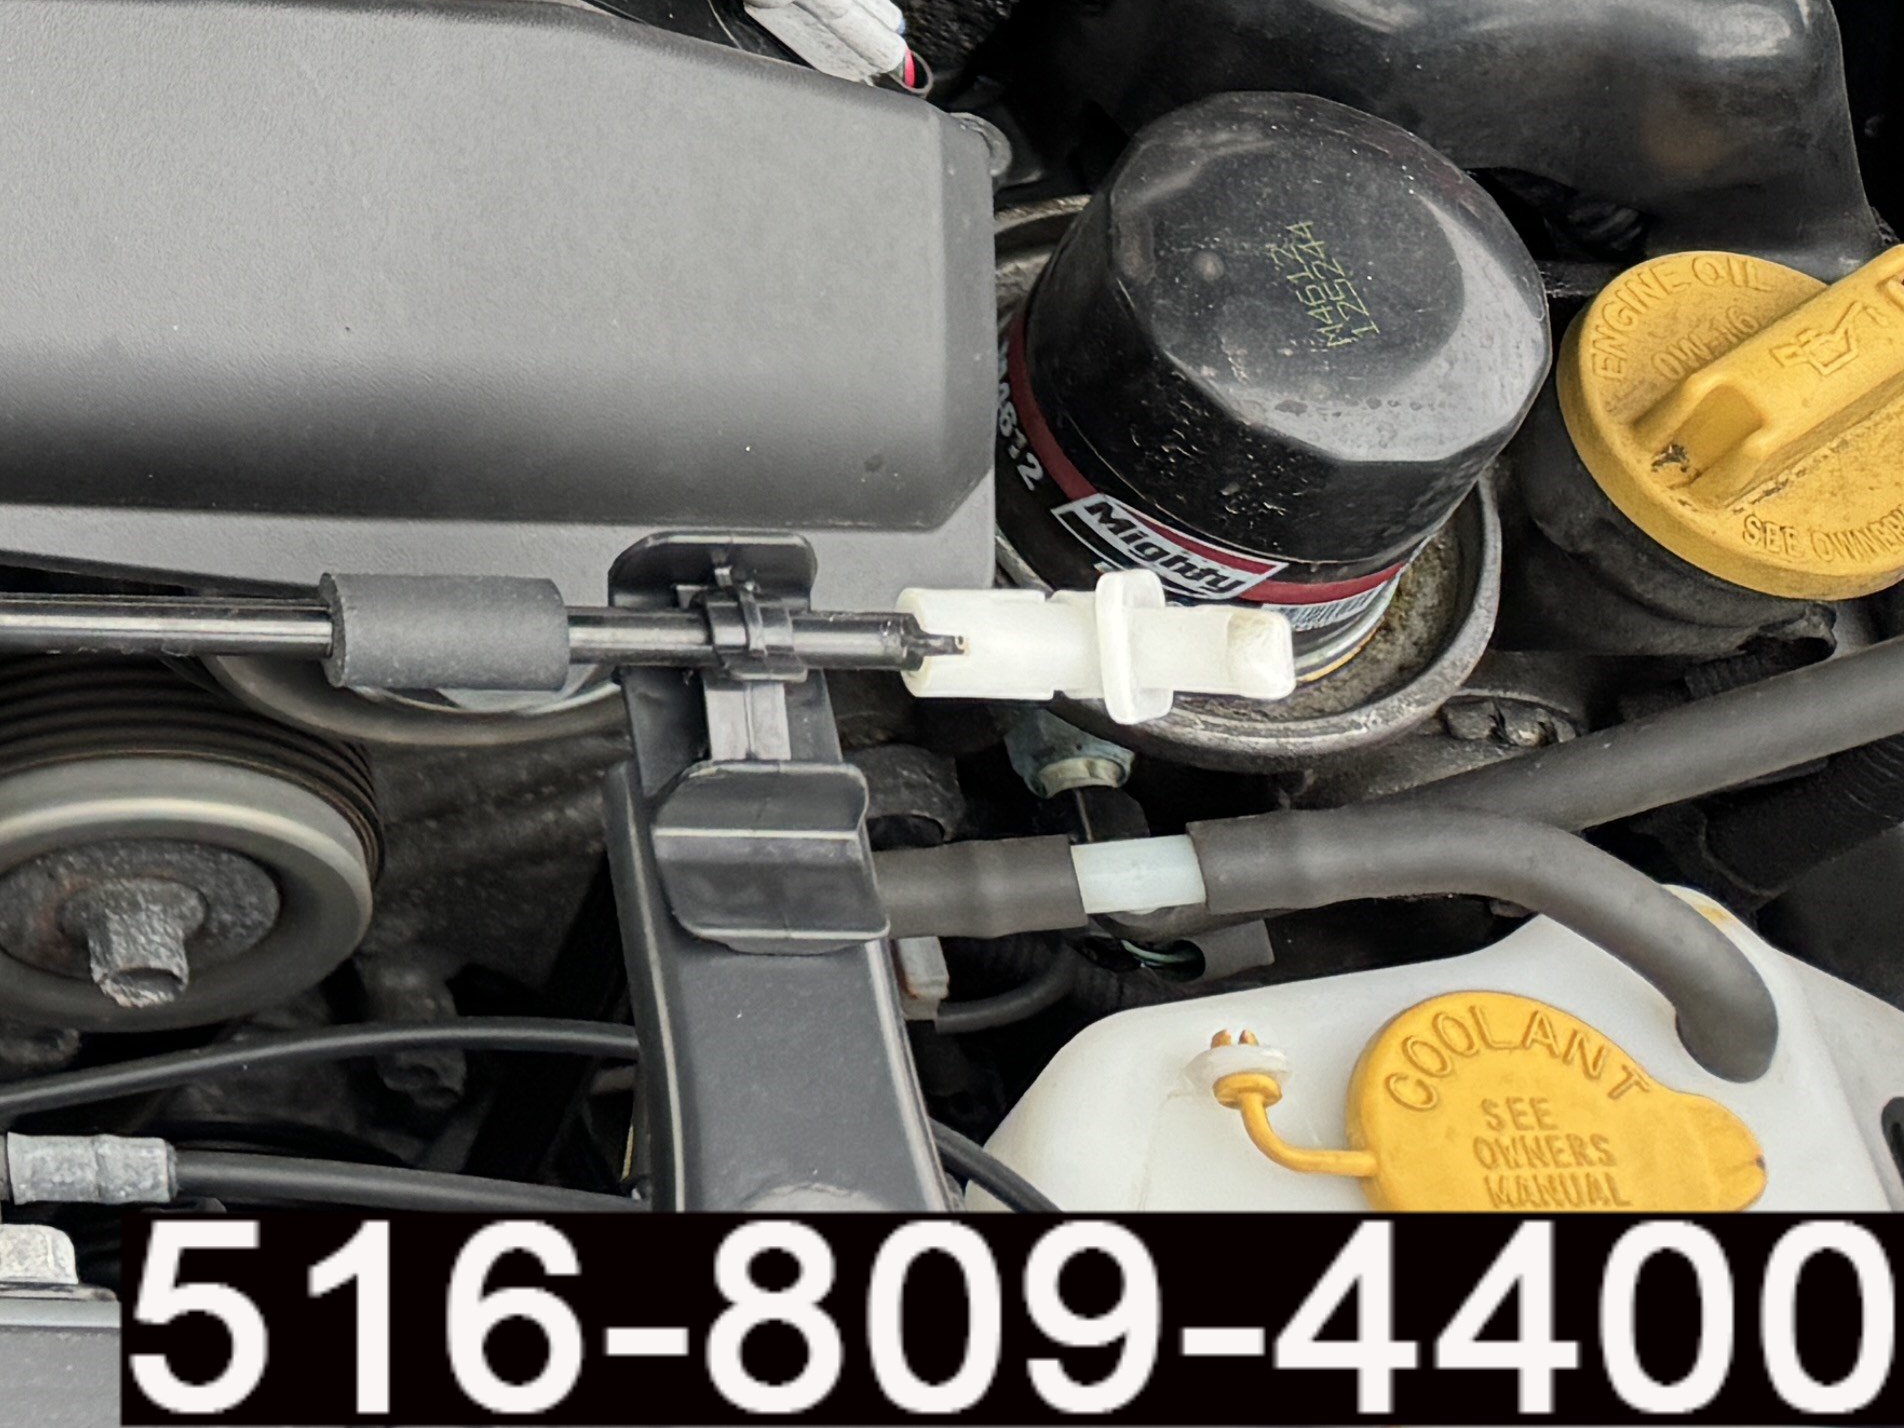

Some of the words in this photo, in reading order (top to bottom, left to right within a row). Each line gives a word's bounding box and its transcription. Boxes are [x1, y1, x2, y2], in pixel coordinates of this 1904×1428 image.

[1267, 243, 1356, 349] M4612
[1285, 220, 1381, 338] 125244
[1591, 261, 1686, 382] ENGINE
[1691, 255, 1774, 292] OIL
[1651, 306, 1759, 381] 0W-16
[1085, 500, 1247, 593] Mighty
[1741, 514, 1806, 557] SEE
[1384, 1004, 1650, 1113] COOLANT
[1472, 1132, 1618, 1170] OWNERS
[1480, 1096, 1559, 1132] SEE
[1483, 1171, 1633, 1210] MANUAL
